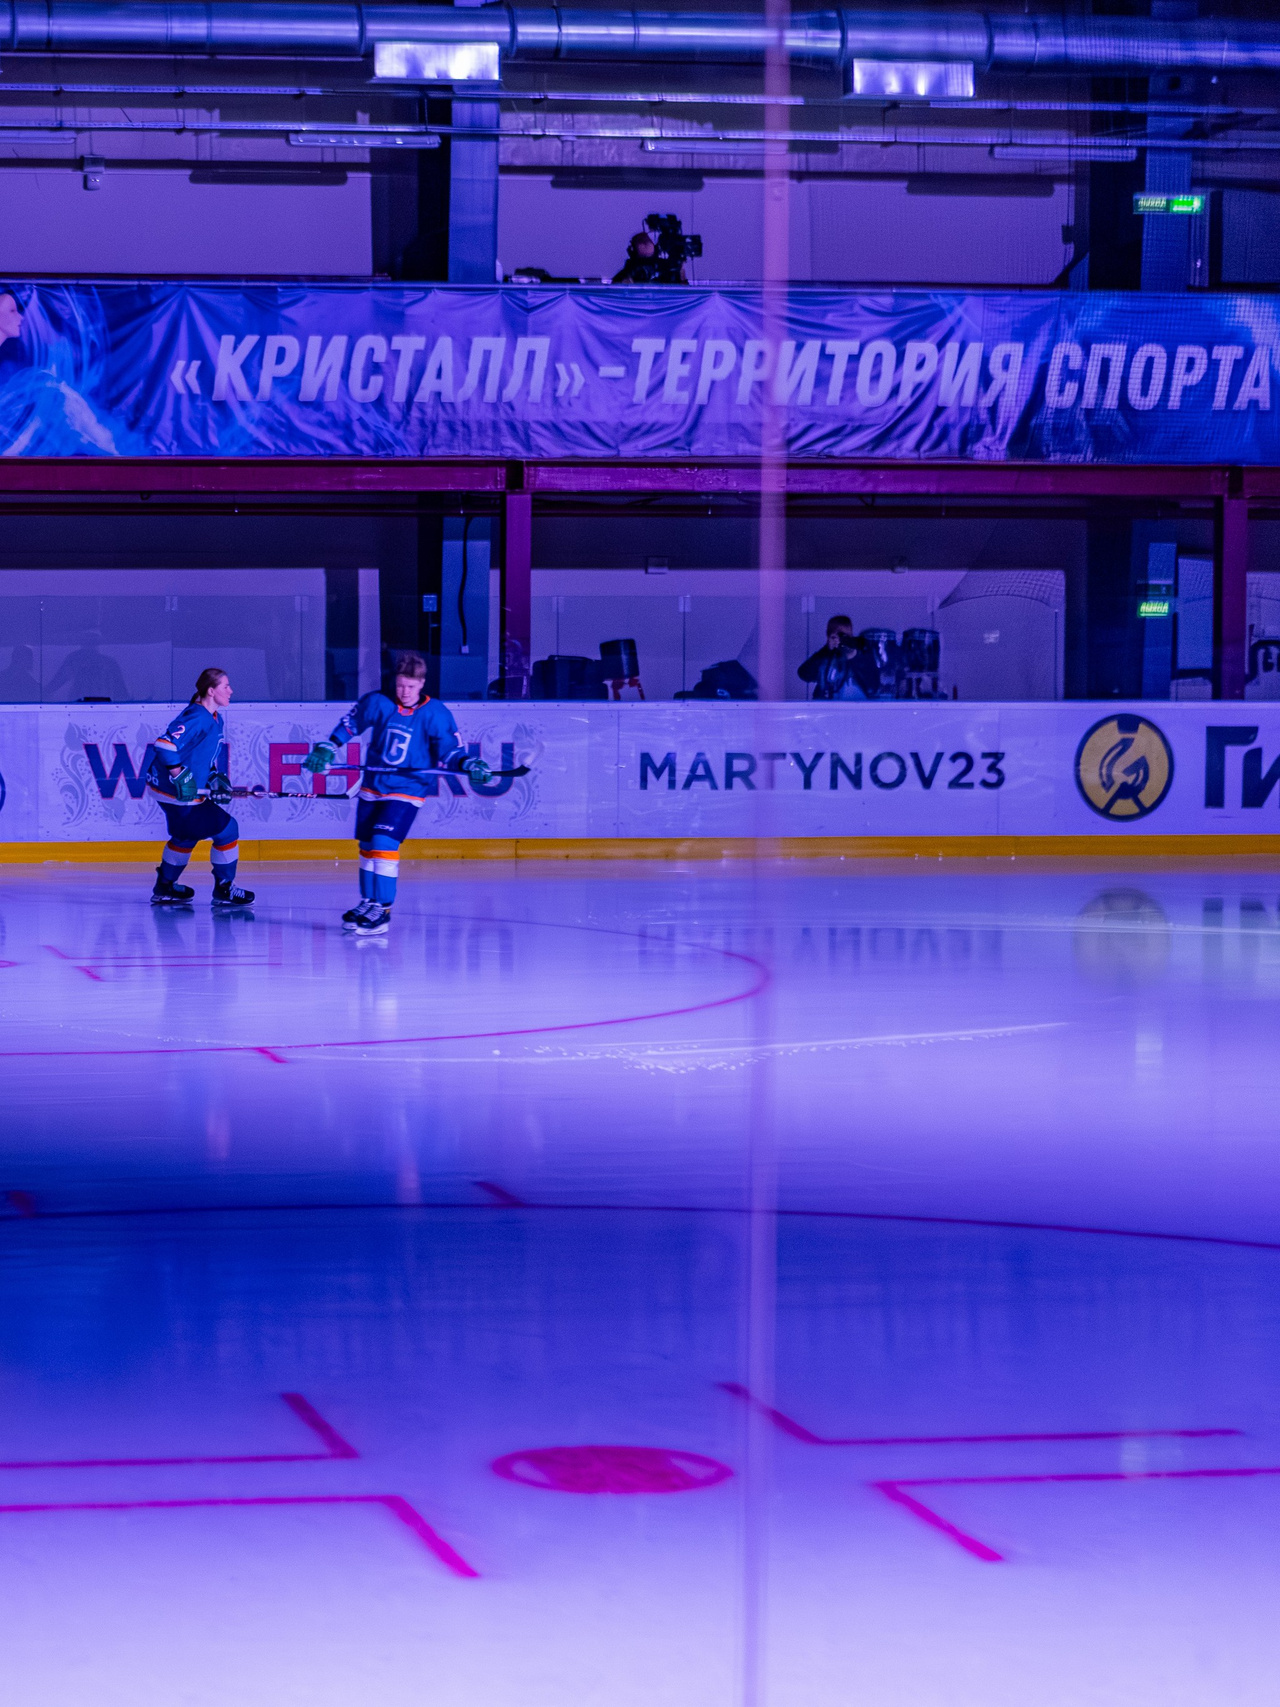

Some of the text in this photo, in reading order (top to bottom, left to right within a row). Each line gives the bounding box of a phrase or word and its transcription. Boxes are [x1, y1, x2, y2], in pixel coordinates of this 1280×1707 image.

[169, 334, 586, 404] «КРИСТАЛЛ»
[630, 338, 1024, 408] ТЕРРИТОРИЯ
[1044, 343, 1272, 412] СПОРТА
[171, 724, 186, 740] 2
[639, 752, 1006, 791] MARTYNOV23
